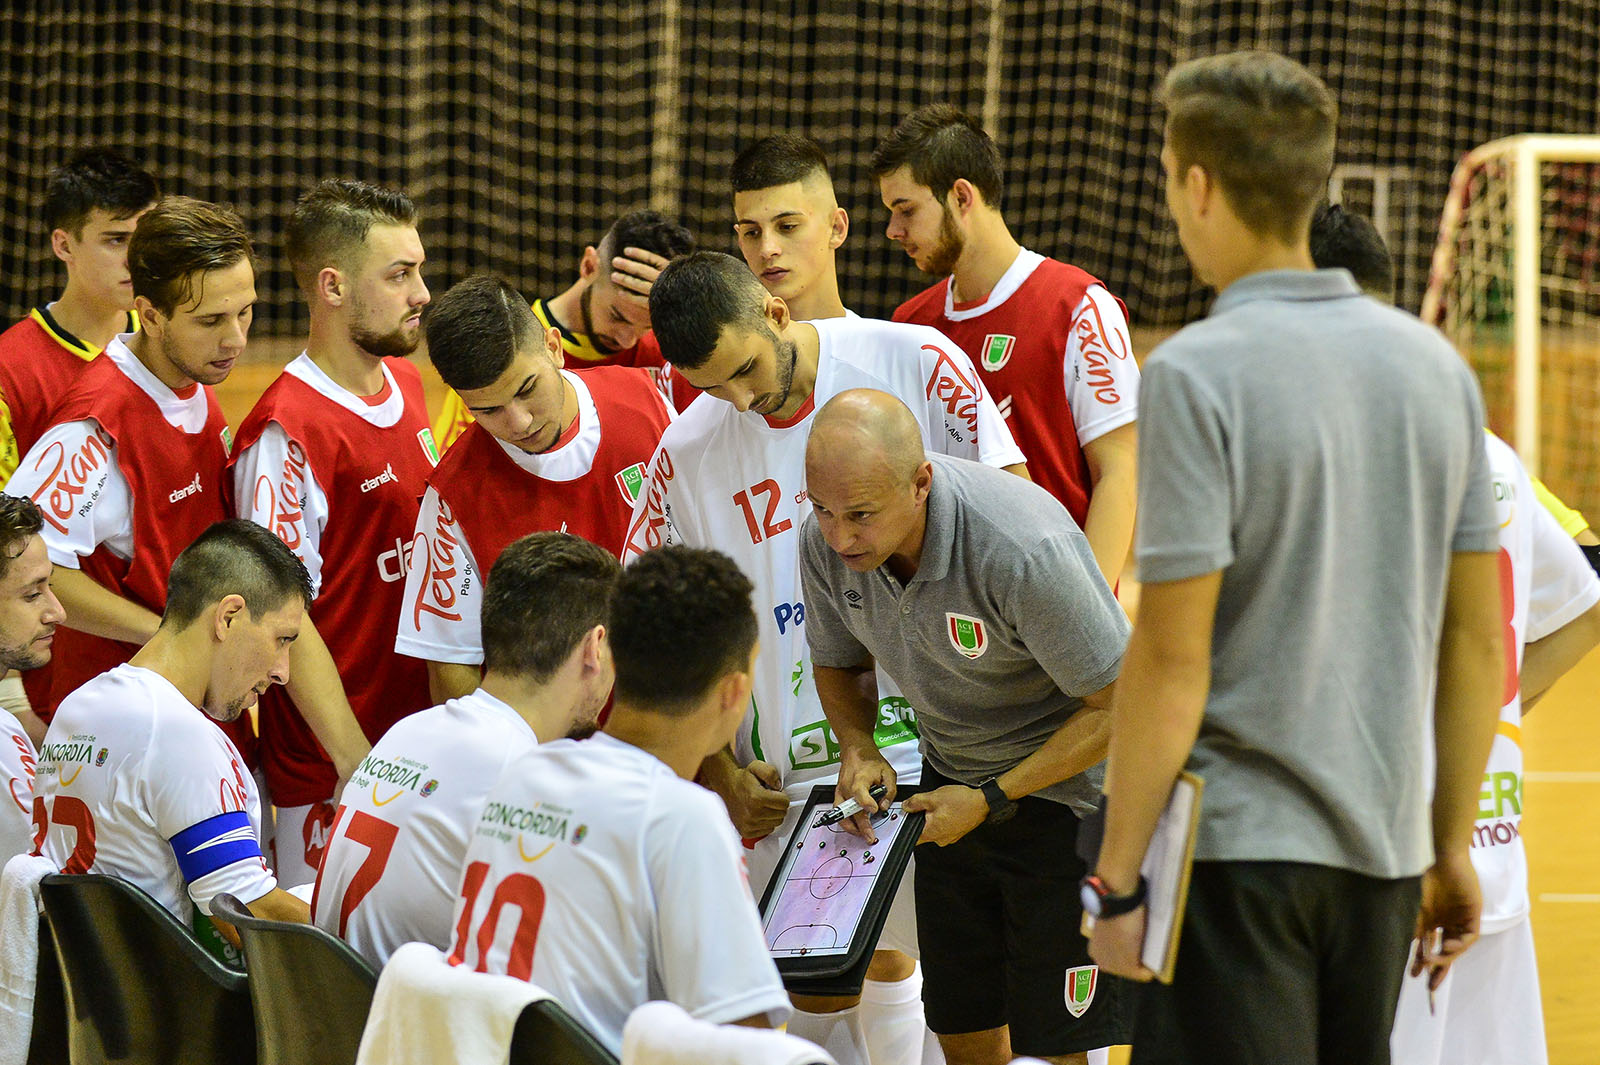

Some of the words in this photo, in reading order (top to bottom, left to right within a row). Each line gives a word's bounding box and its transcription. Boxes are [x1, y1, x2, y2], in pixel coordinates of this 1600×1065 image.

[1069, 292, 1127, 404] Texano
[78, 500, 94, 518] Pão
[732, 478, 792, 544] 12
[460, 574, 471, 596] Pão
[310, 805, 399, 940] 17
[447, 860, 545, 982] 10
